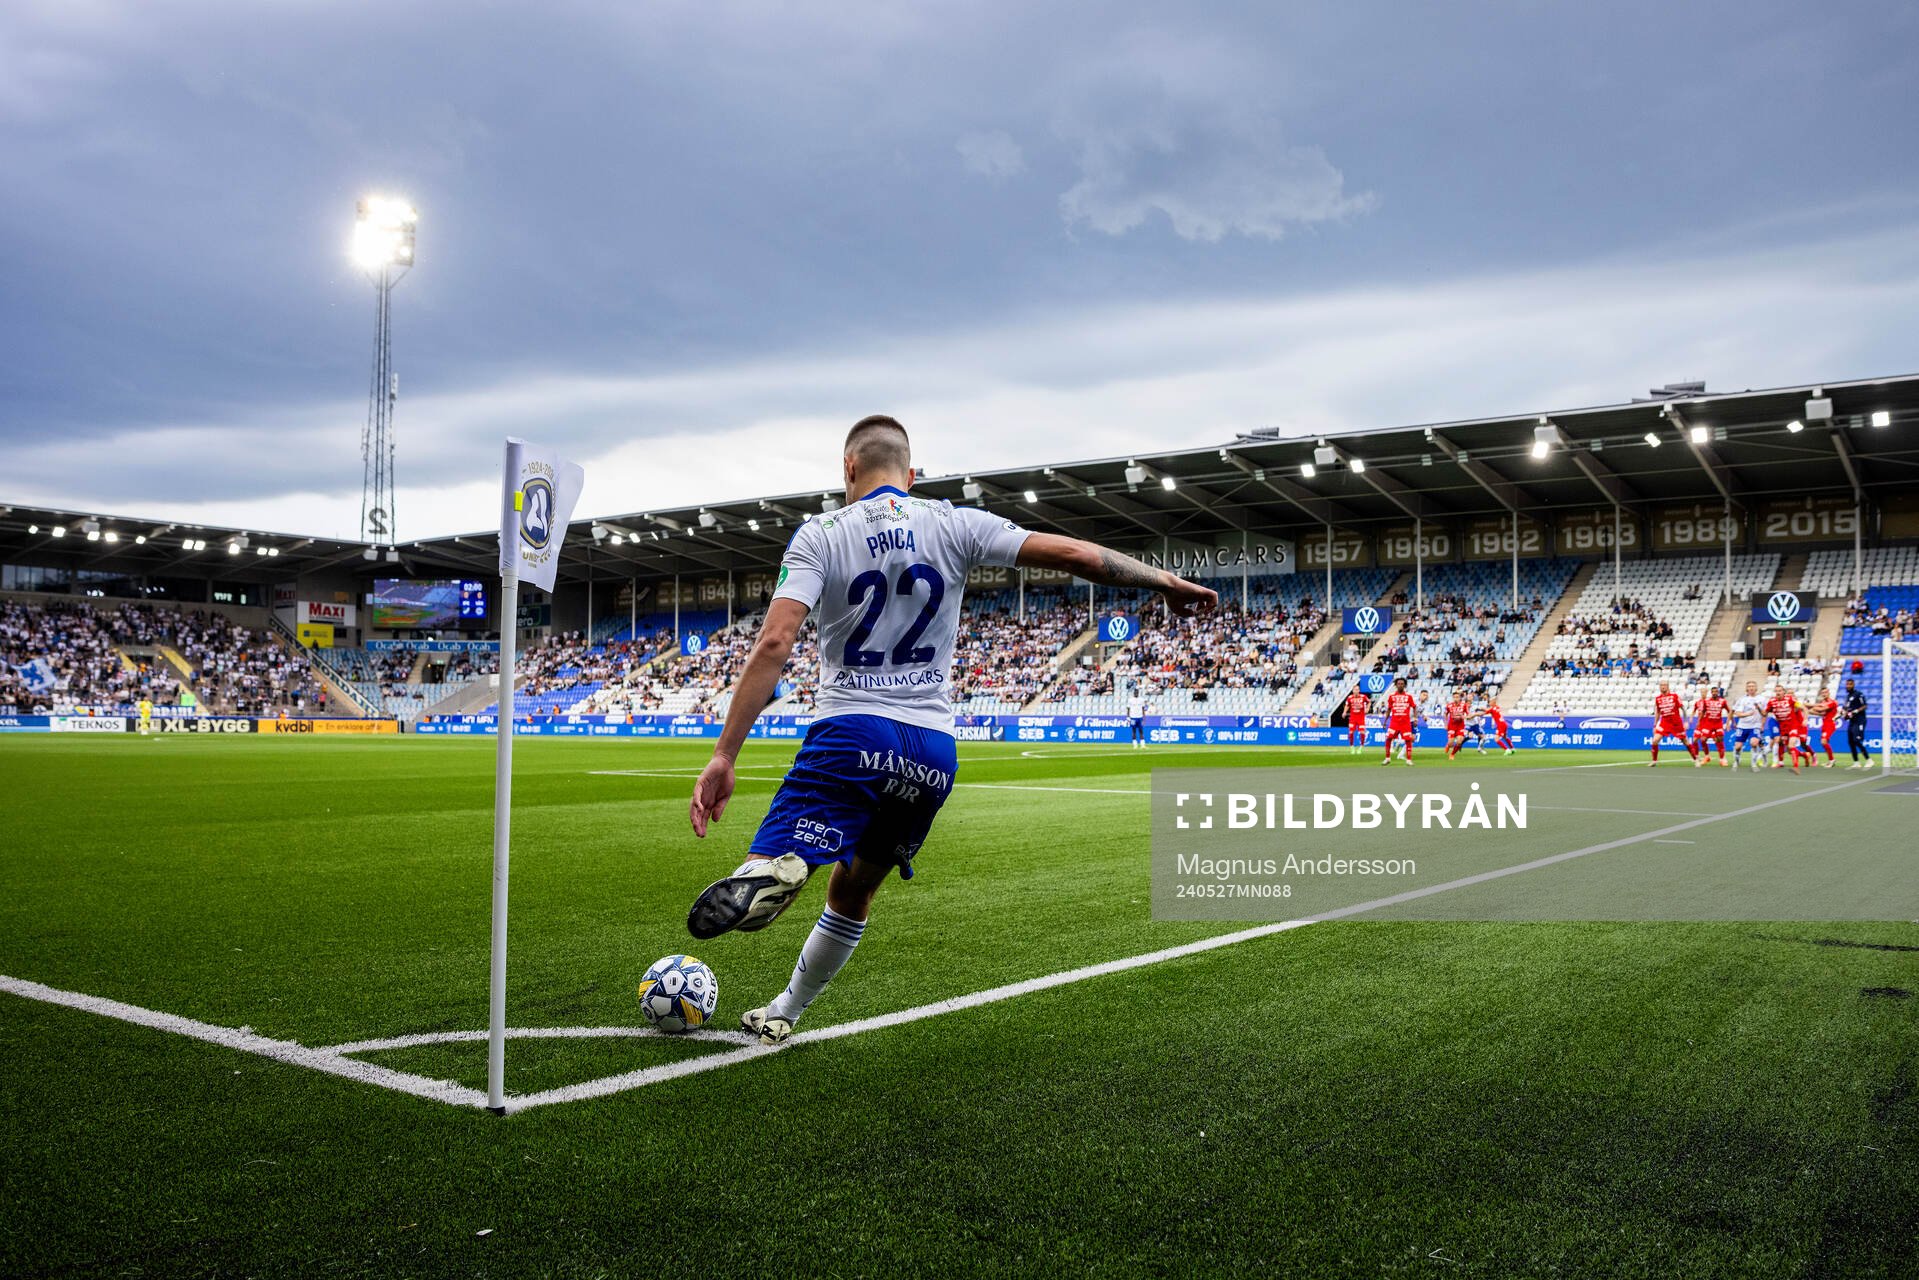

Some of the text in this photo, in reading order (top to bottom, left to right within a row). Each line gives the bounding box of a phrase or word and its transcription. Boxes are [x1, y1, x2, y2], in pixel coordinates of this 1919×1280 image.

[1660, 516, 1739, 545] 1989
[1766, 509, 1858, 538] 2015
[866, 528, 916, 559] PRICA
[1470, 529, 1540, 555] 1962
[1562, 523, 1636, 549] 1963
[1303, 540, 1363, 565] 1957
[1384, 535, 1449, 560] 1960
[969, 566, 1007, 583] 952
[843, 563, 944, 667] 22
[406, 641, 430, 651] Ocab
[437, 641, 461, 651] Ocab
[71, 720, 119, 729] TEKNOS
[163, 719, 249, 732] XL-BYGG
[275, 720, 314, 733] kvdbil
[1018, 728, 1045, 740] SEB
[1150, 729, 1179, 741] SEB
[858, 750, 950, 791] MÅNSSON
[796, 818, 825, 834] pre
[793, 830, 829, 849] zero
